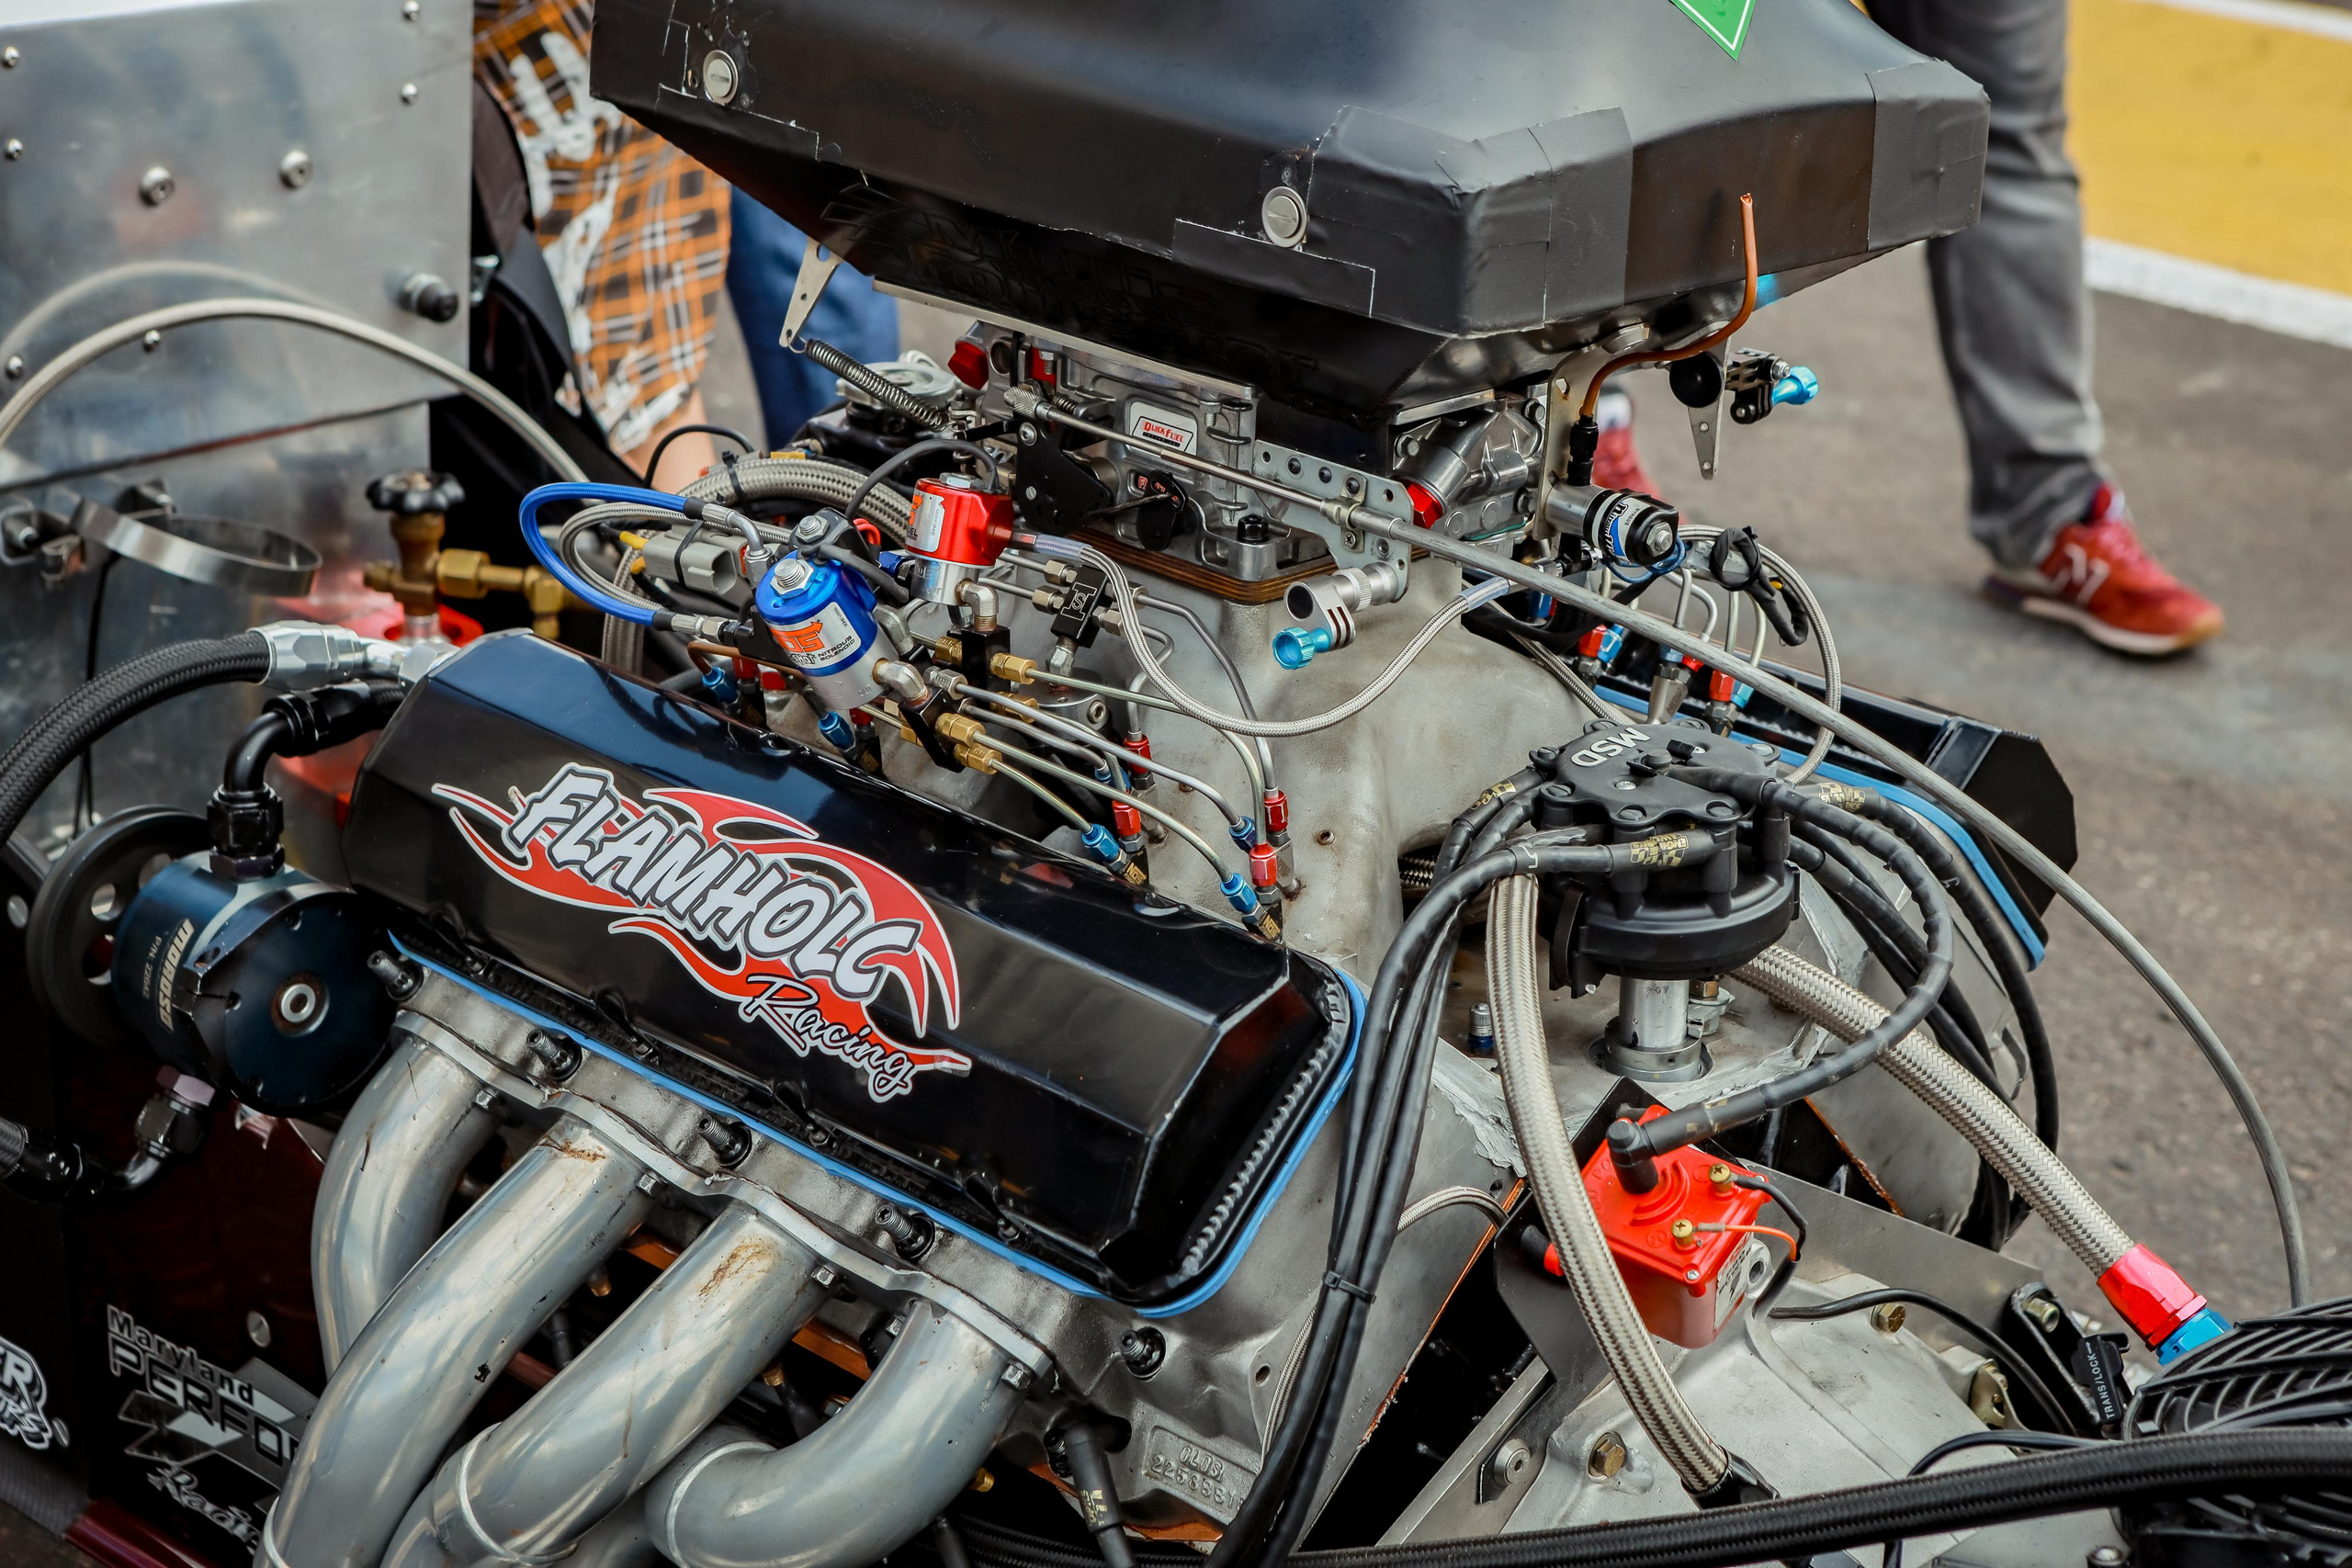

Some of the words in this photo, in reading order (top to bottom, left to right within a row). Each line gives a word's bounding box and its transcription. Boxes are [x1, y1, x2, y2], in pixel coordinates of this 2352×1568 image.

[770, 621, 826, 654] OS
[818, 635, 853, 658] NITROUS
[820, 639, 855, 661] SOLENOID
[857, 684, 873, 698] OUT
[1571, 727, 1651, 767] MSD
[502, 762, 924, 1000] FLAMHOLC
[1126, 863, 1147, 886] NOS
[1263, 915, 1281, 939] NOS
[158, 918, 196, 1032] MOROSO
[741, 974, 917, 1101] Racing
[107, 1303, 254, 1406] Maryland
[2087, 1353, 2115, 1419] TRANS/LOCK
[1180, 1446, 1224, 1479] OLDS
